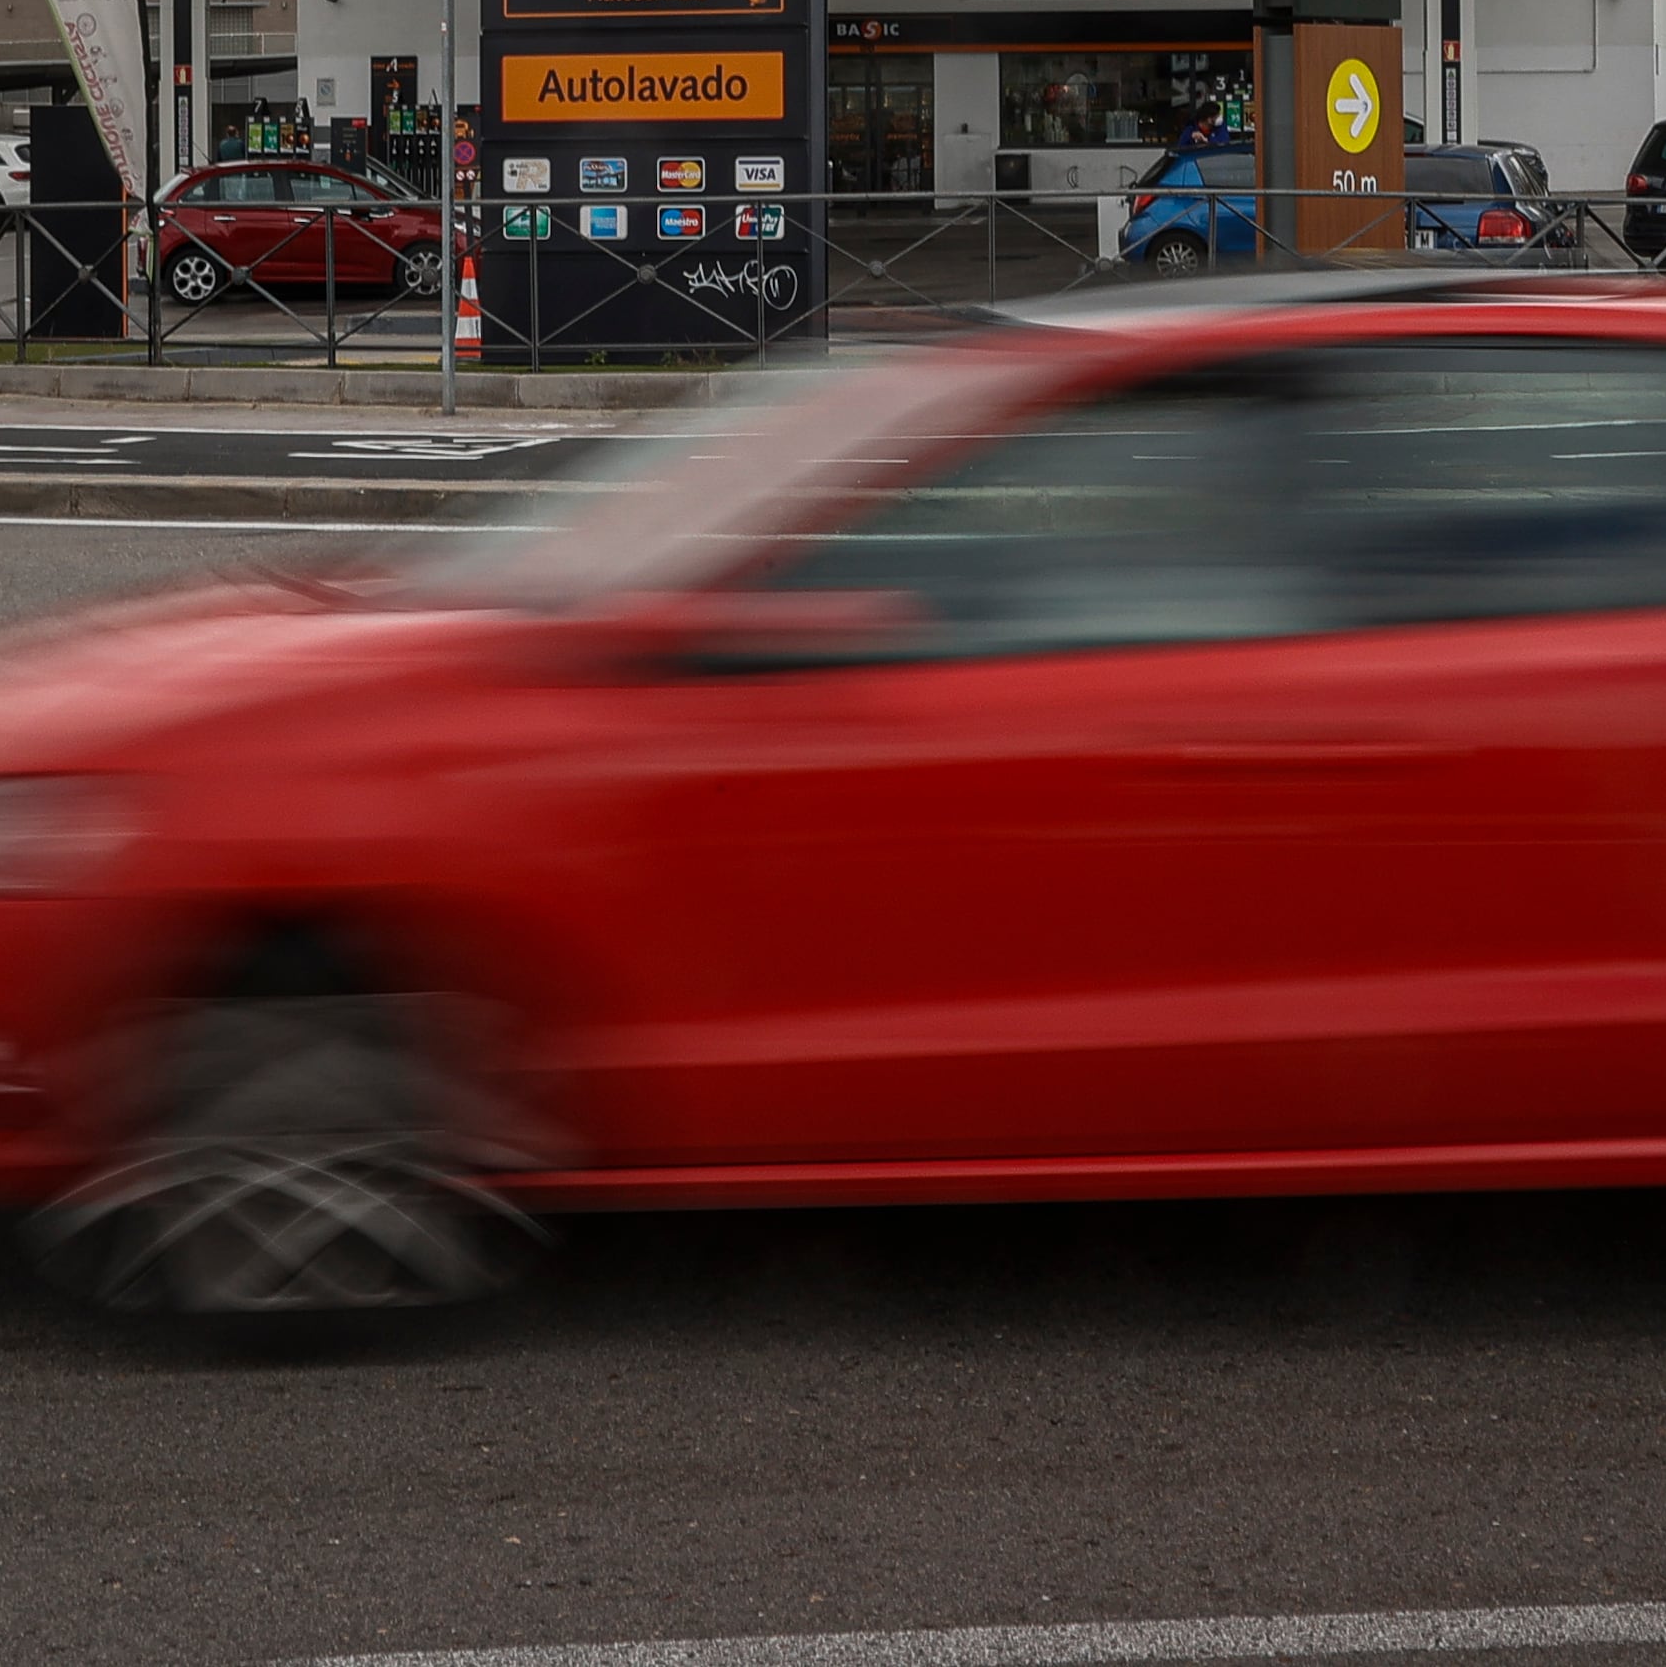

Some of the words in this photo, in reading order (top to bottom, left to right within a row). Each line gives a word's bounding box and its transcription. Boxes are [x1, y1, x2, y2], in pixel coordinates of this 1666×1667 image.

[835, 21, 900, 38] BASIC
[538, 65, 749, 105] Autolavado
[744, 167, 776, 181] VISA
[1332, 170, 1357, 192] 50
[664, 216, 699, 227] Maestro
